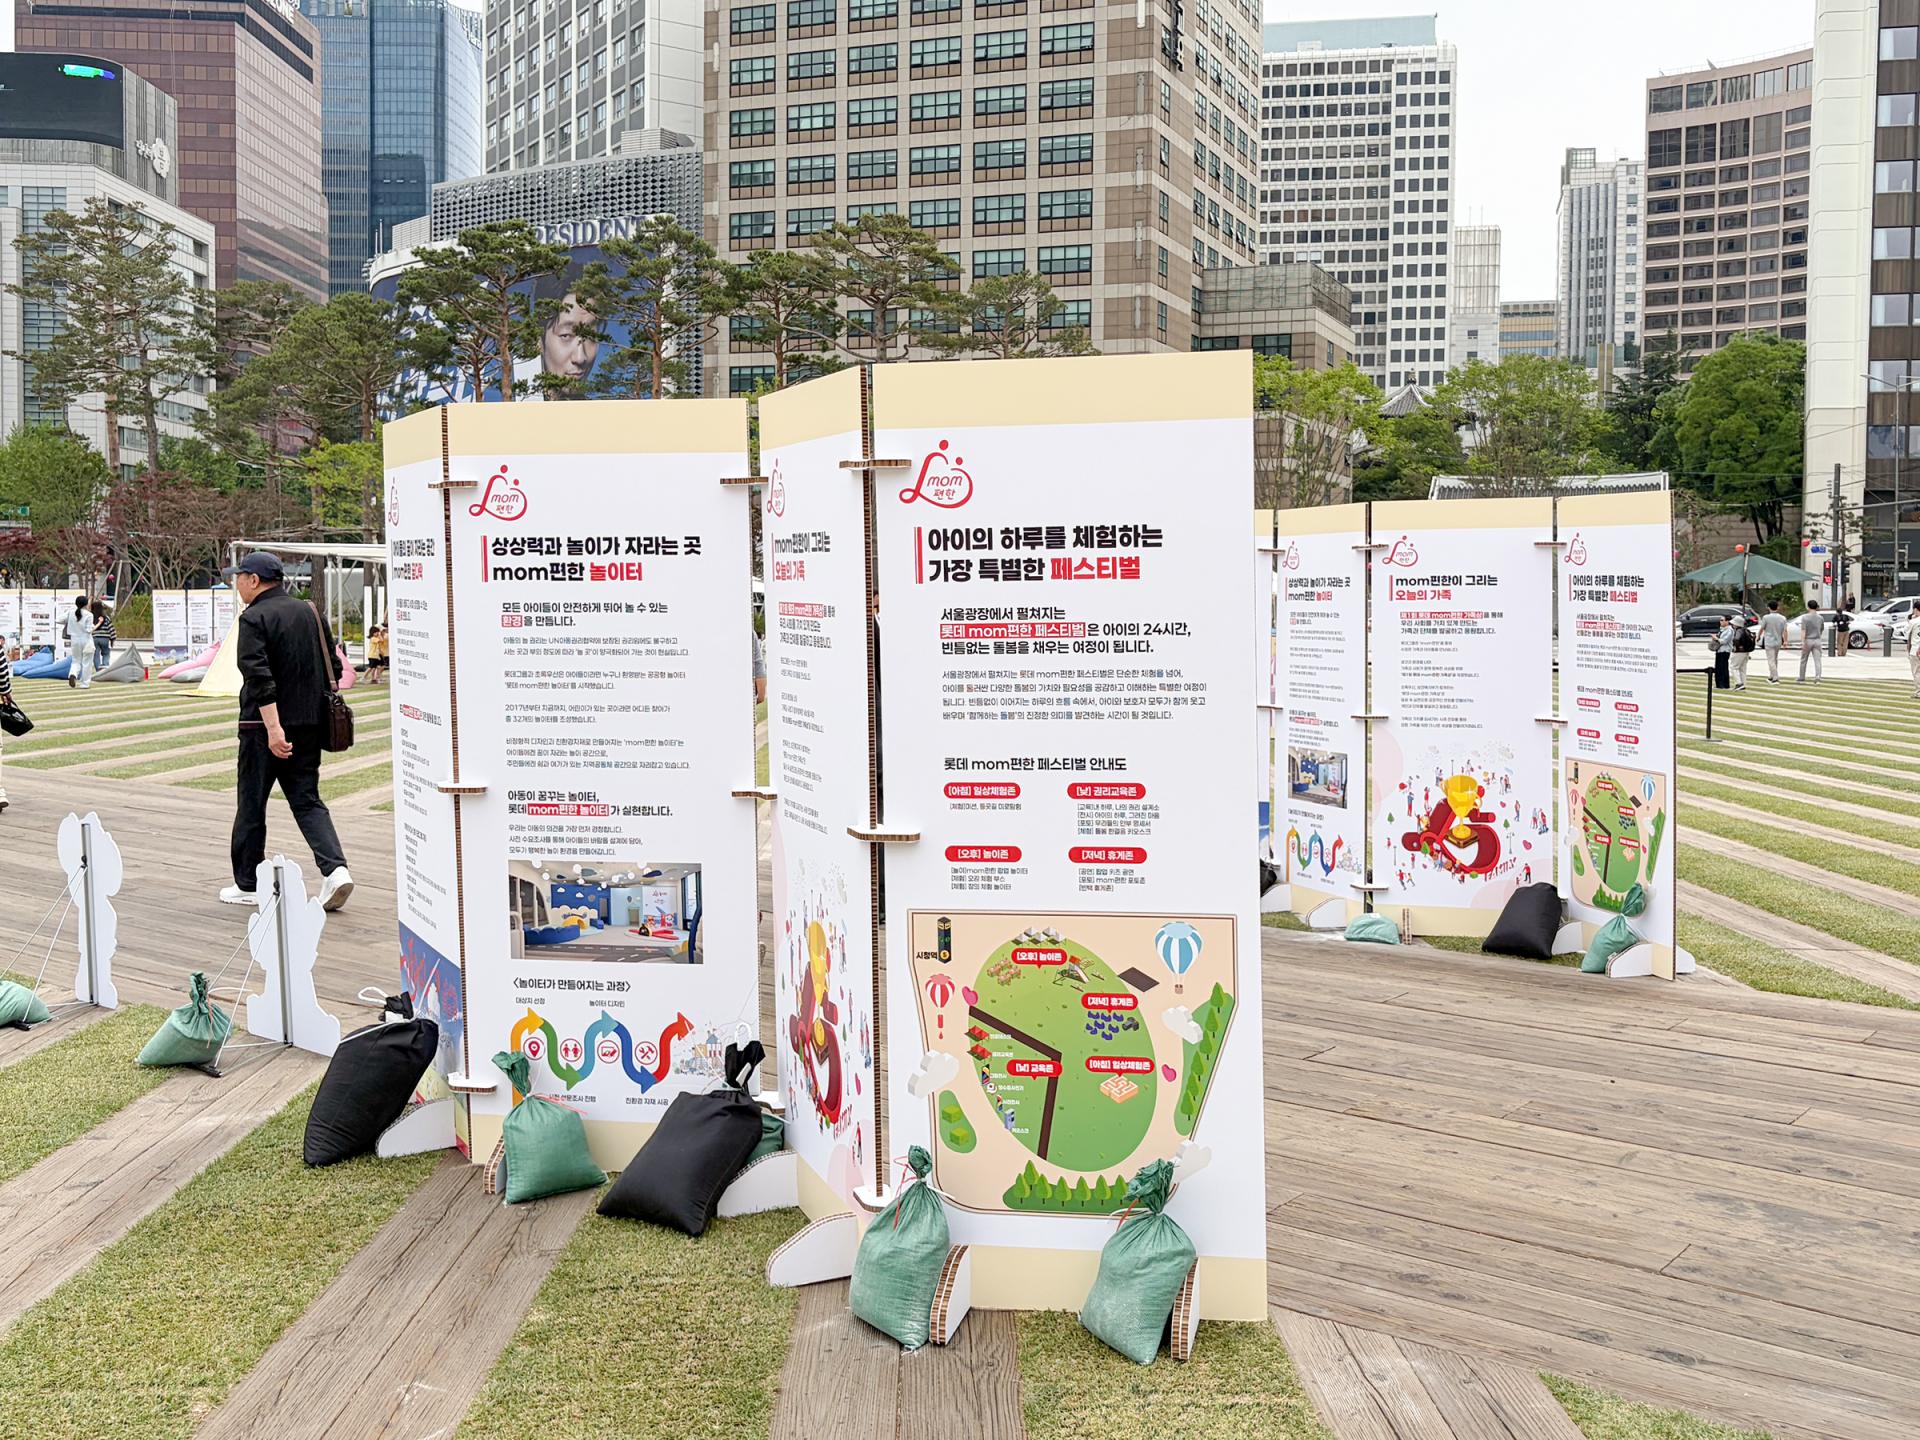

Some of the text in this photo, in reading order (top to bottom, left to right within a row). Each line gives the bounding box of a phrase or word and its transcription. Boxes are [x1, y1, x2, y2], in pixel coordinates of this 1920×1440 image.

[927, 475, 962, 486] mom
[491, 494, 519, 503] mom
[933, 489, 955, 500] 편한
[928, 524, 1162, 551] 아이의 하루를 체험하는
[492, 536, 700, 555] 상상력과 놀이가 자라는 곳
[493, 562, 641, 581] mom편한 놀이터
[929, 556, 1139, 582] 가장 특별한 페스티벌
[1288, 577, 1308, 587] 상상력과
[1327, 577, 1342, 587] 자라는
[1396, 574, 1497, 586] mom편한이 그리는
[1573, 574, 1644, 587] 아이의 하루를 체험하는
[1395, 589, 1451, 600] 오늘의 가족
[1573, 590, 1586, 601] 가장
[1610, 590, 1637, 602] 페스티벌
[502, 602, 667, 612] 모든 아이들이 안전하게 뛰어 놀 수 있는
[941, 606, 1065, 620] 서울광장에서 펼쳐지는
[535, 616, 575, 626] 만듭니다.
[941, 624, 965, 637] 롯데
[969, 624, 1032, 637] mom편한
[1103, 623, 1139, 635] 아이의
[1143, 622, 1190, 636] 24시간,
[942, 640, 1153, 654] 빈틈없는 돌봄을 채우는 여정이 됩니다.
[942, 670, 986, 678] 서울광장에서
[1036, 669, 1075, 678] mom편한
[1076, 669, 1114, 678] 페스티벌은
[1116, 669, 1139, 677] 단순한
[990, 684, 1012, 692] 다양한
[944, 757, 1126, 770] 롯데 mom편한 페스티벌 안내도
[508, 790, 599, 802] 아동이 꿈꾸는 놀이터,
[508, 804, 526, 814] 롯데
[529, 805, 578, 815] mom편한
[622, 805, 672, 816] 실현합니다.
[557, 979, 603, 990] 만들어지는
